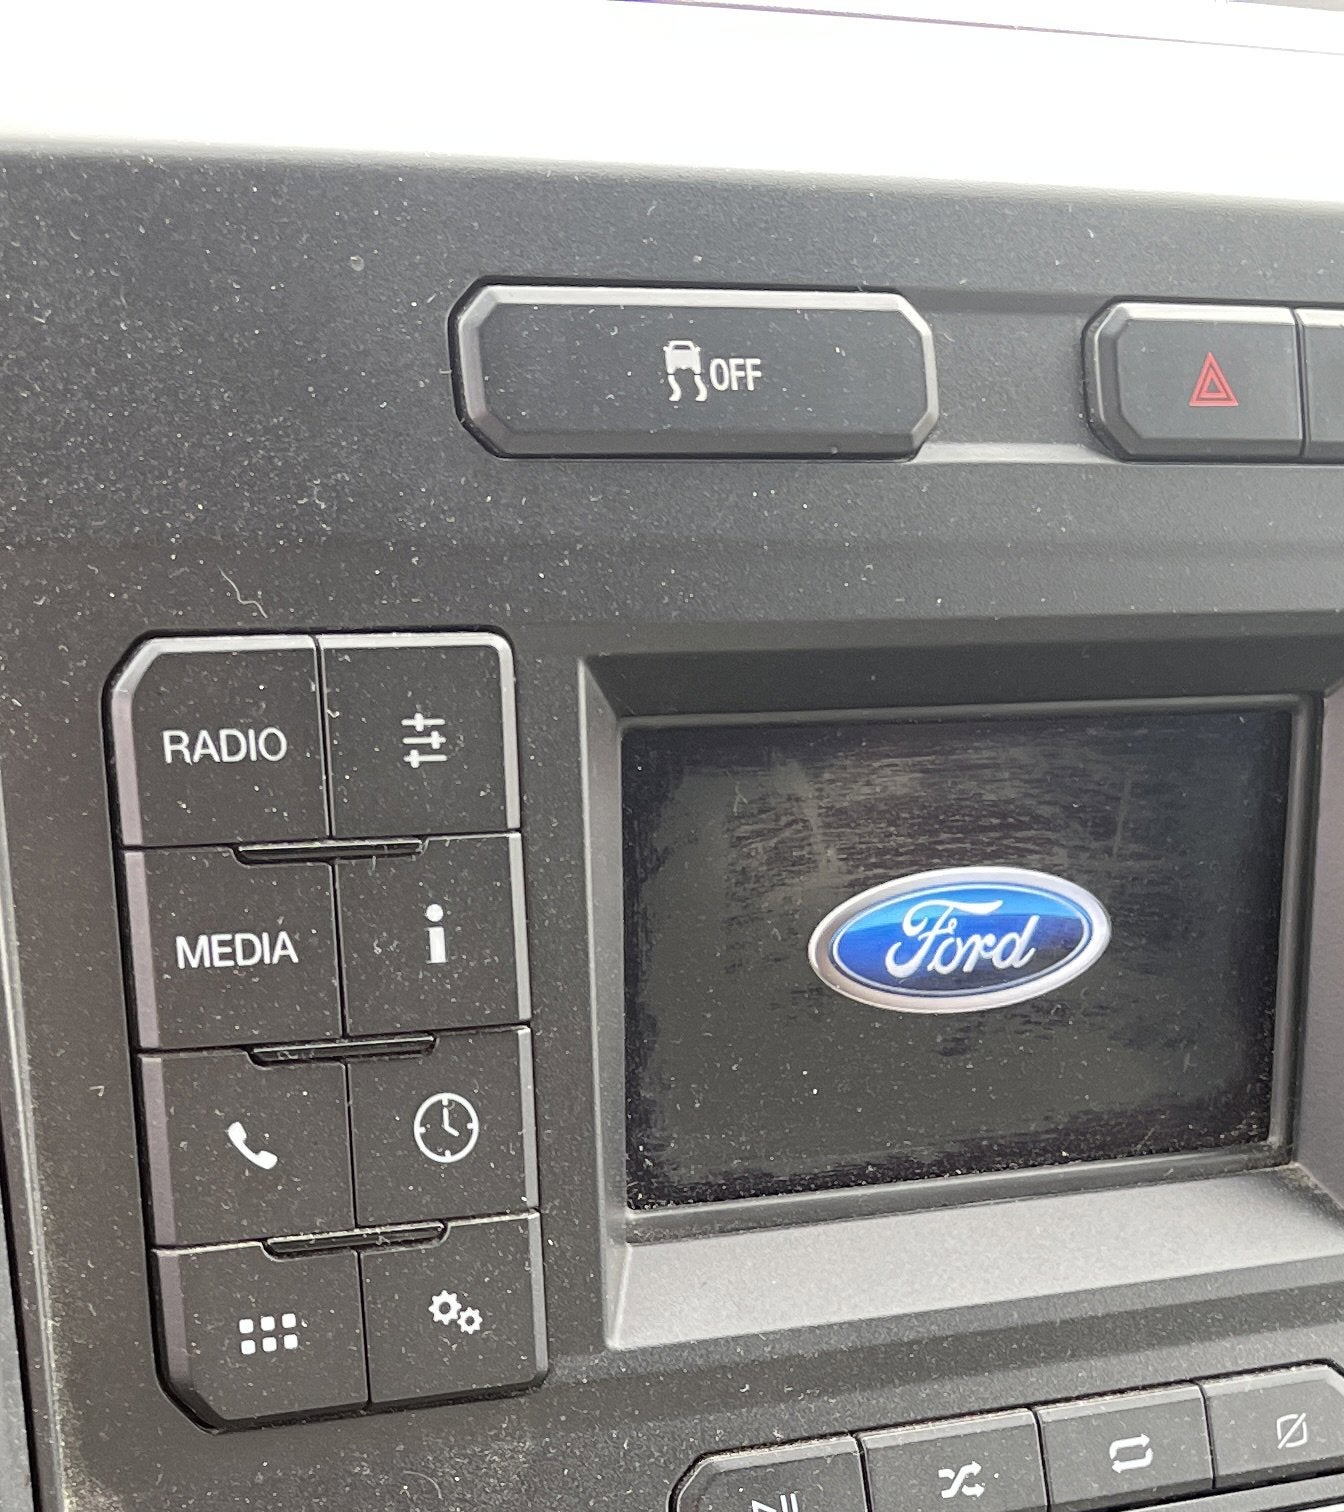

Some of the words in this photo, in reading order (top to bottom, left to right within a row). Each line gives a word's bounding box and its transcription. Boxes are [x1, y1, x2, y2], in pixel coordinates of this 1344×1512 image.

[710, 358, 761, 390] OFF
[162, 726, 288, 765] RADIO
[176, 931, 299, 970] MEDIA
[885, 900, 1040, 978] Ford
